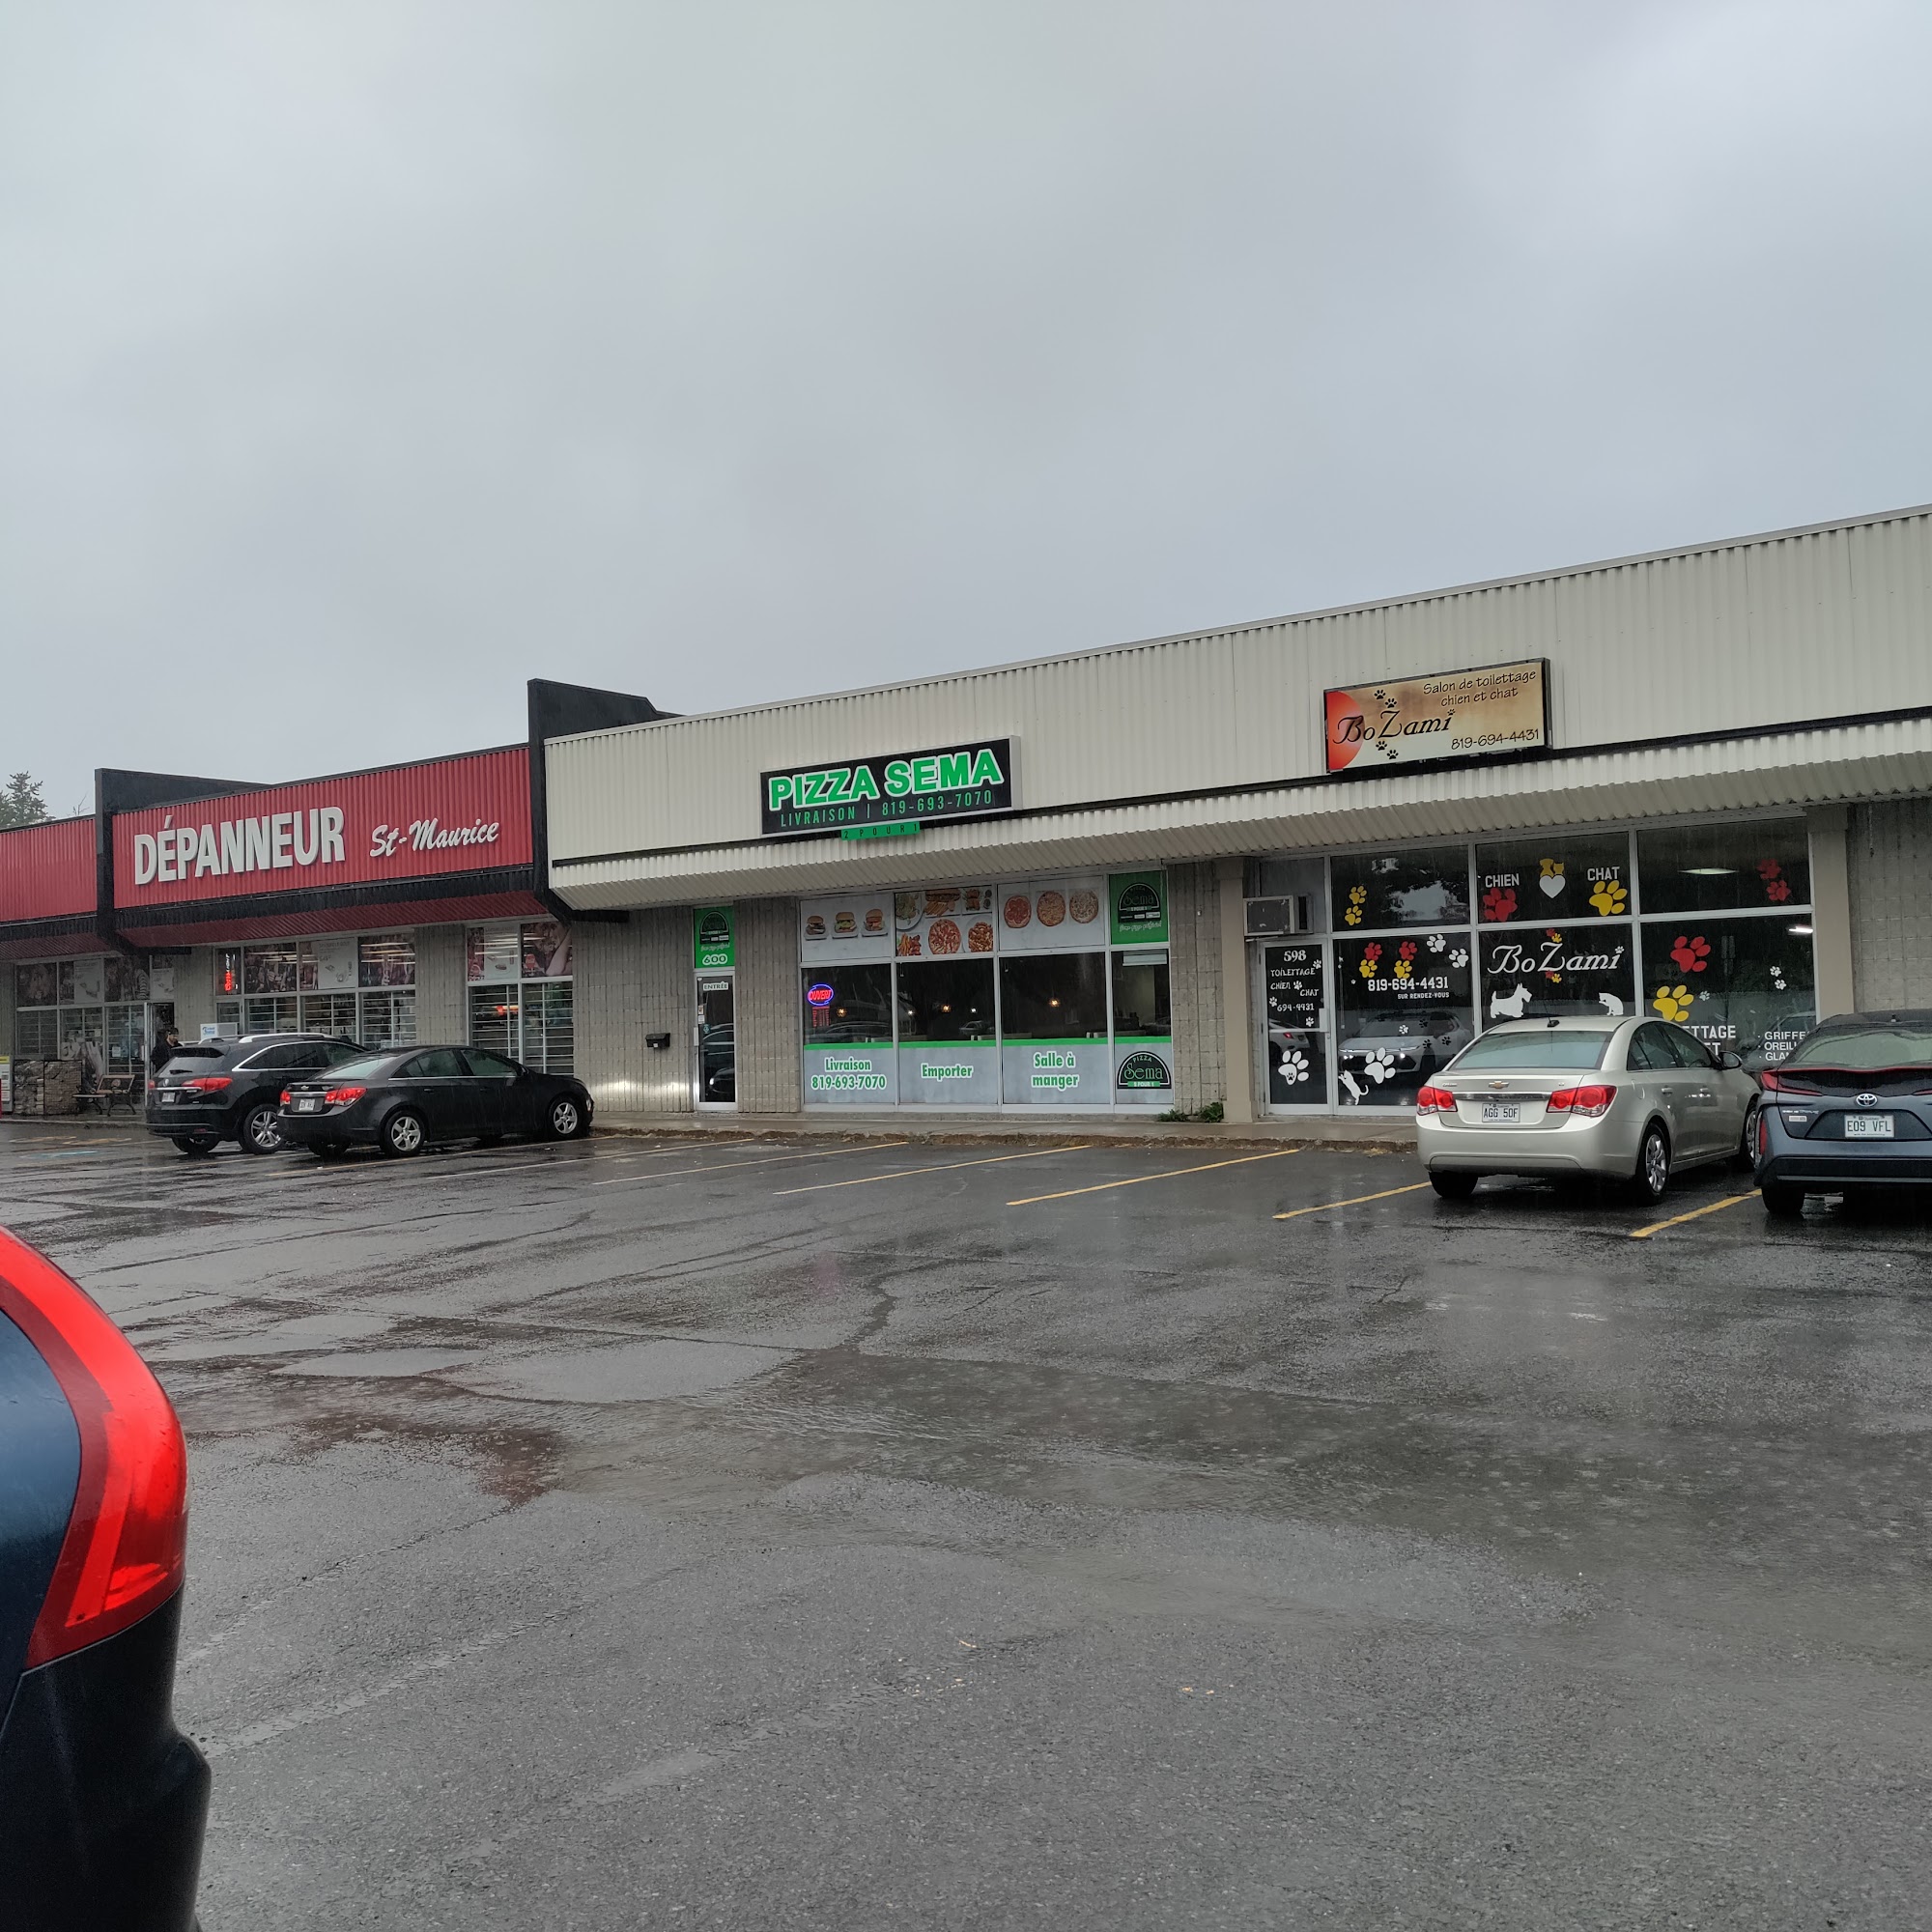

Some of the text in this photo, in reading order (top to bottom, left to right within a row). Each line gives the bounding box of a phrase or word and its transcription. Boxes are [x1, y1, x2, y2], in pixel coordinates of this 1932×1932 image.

[1423, 669, 1536, 696] Salon de toilettage
[1440, 686, 1519, 707] chien et chat
[1332, 709, 1456, 745] BoZami
[1451, 727, 1540, 751] 819-694-4431
[769, 748, 1005, 811] PIZZA SEMA
[781, 789, 993, 828] LIVRAISON 819-693-7070
[369, 817, 500, 858] St-Maurice
[843, 824, 918, 839] 2 POUR 1
[133, 806, 346, 885] DÉPANNEUR
[1485, 873, 1520, 888] CHIEN
[1587, 866, 1620, 881] CHAT
[701, 952, 728, 966] 600
[1283, 949, 1307, 962] 598
[1487, 942, 1625, 975] BoZami
[703, 980, 728, 991] ENTRÉE
[1367, 976, 1449, 991] 819-694-4431
[1299, 988, 1320, 997] CHAT
[1409, 991, 1450, 1000] RENDEZ-VOUS
[1276, 1003, 1315, 1012] 694-4431
[1764, 1031, 1810, 1040] GRIFFE
[824, 1056, 872, 1072] Livraison
[1034, 1051, 1076, 1068] Salle à
[921, 1063, 974, 1082] Emporter
[1123, 1063, 1164, 1080] Sema
[811, 1074, 887, 1090] 819-693-7070
[1032, 1074, 1079, 1092] manger
[1483, 1108, 1498, 1119] AGG
[1847, 1120, 1891, 1132] E09 VFL
